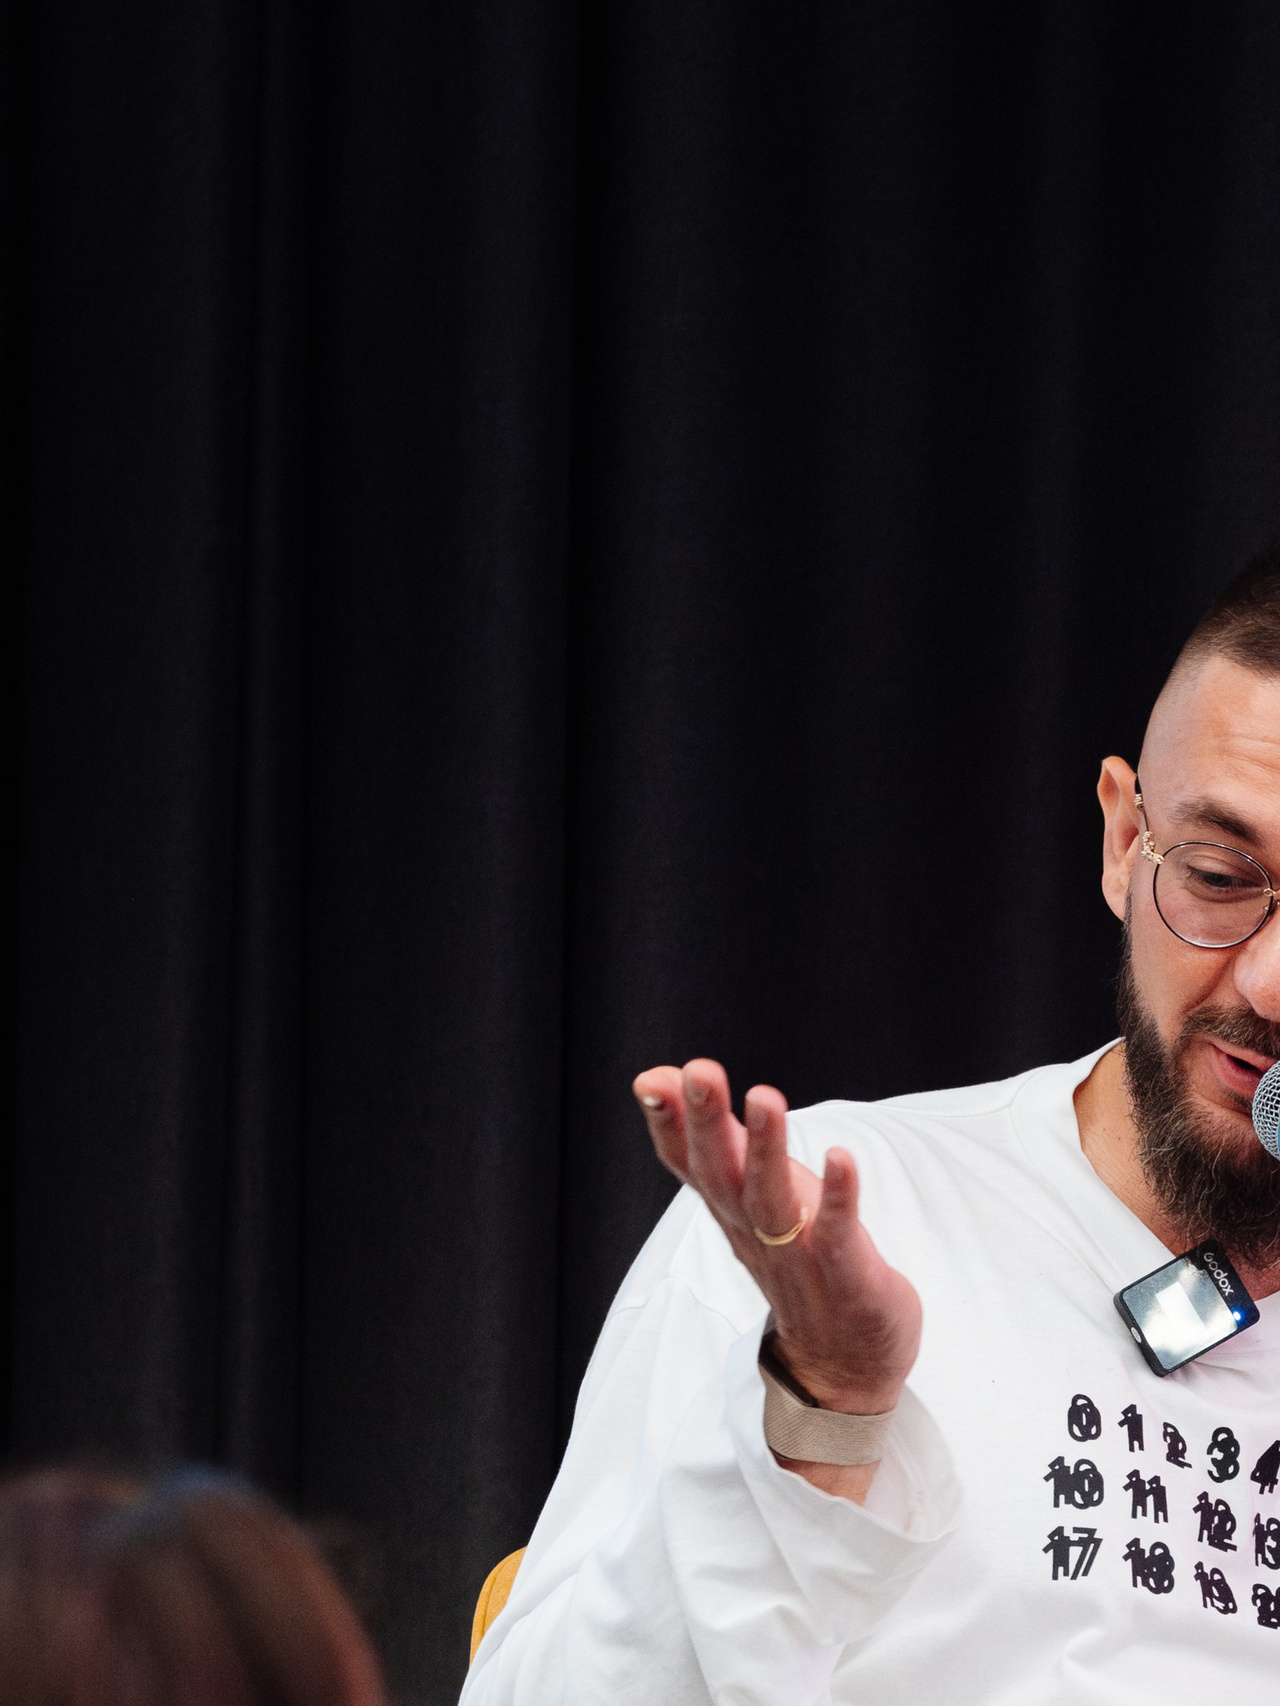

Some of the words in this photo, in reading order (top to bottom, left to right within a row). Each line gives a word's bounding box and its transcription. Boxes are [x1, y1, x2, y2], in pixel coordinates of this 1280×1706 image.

[1203, 1252, 1235, 1297] Godox
[1068, 1394, 1101, 1442] 0
[1118, 1404, 1144, 1452] 1
[1163, 1422, 1192, 1468] 2
[1207, 1427, 1240, 1483] 3
[1044, 1456, 1104, 1509] 10
[1123, 1470, 1168, 1523] 11
[1193, 1491, 1237, 1552] 12
[1043, 1526, 1103, 1580] 17
[1123, 1538, 1174, 1594] 18
[1194, 1561, 1237, 1614] 19
